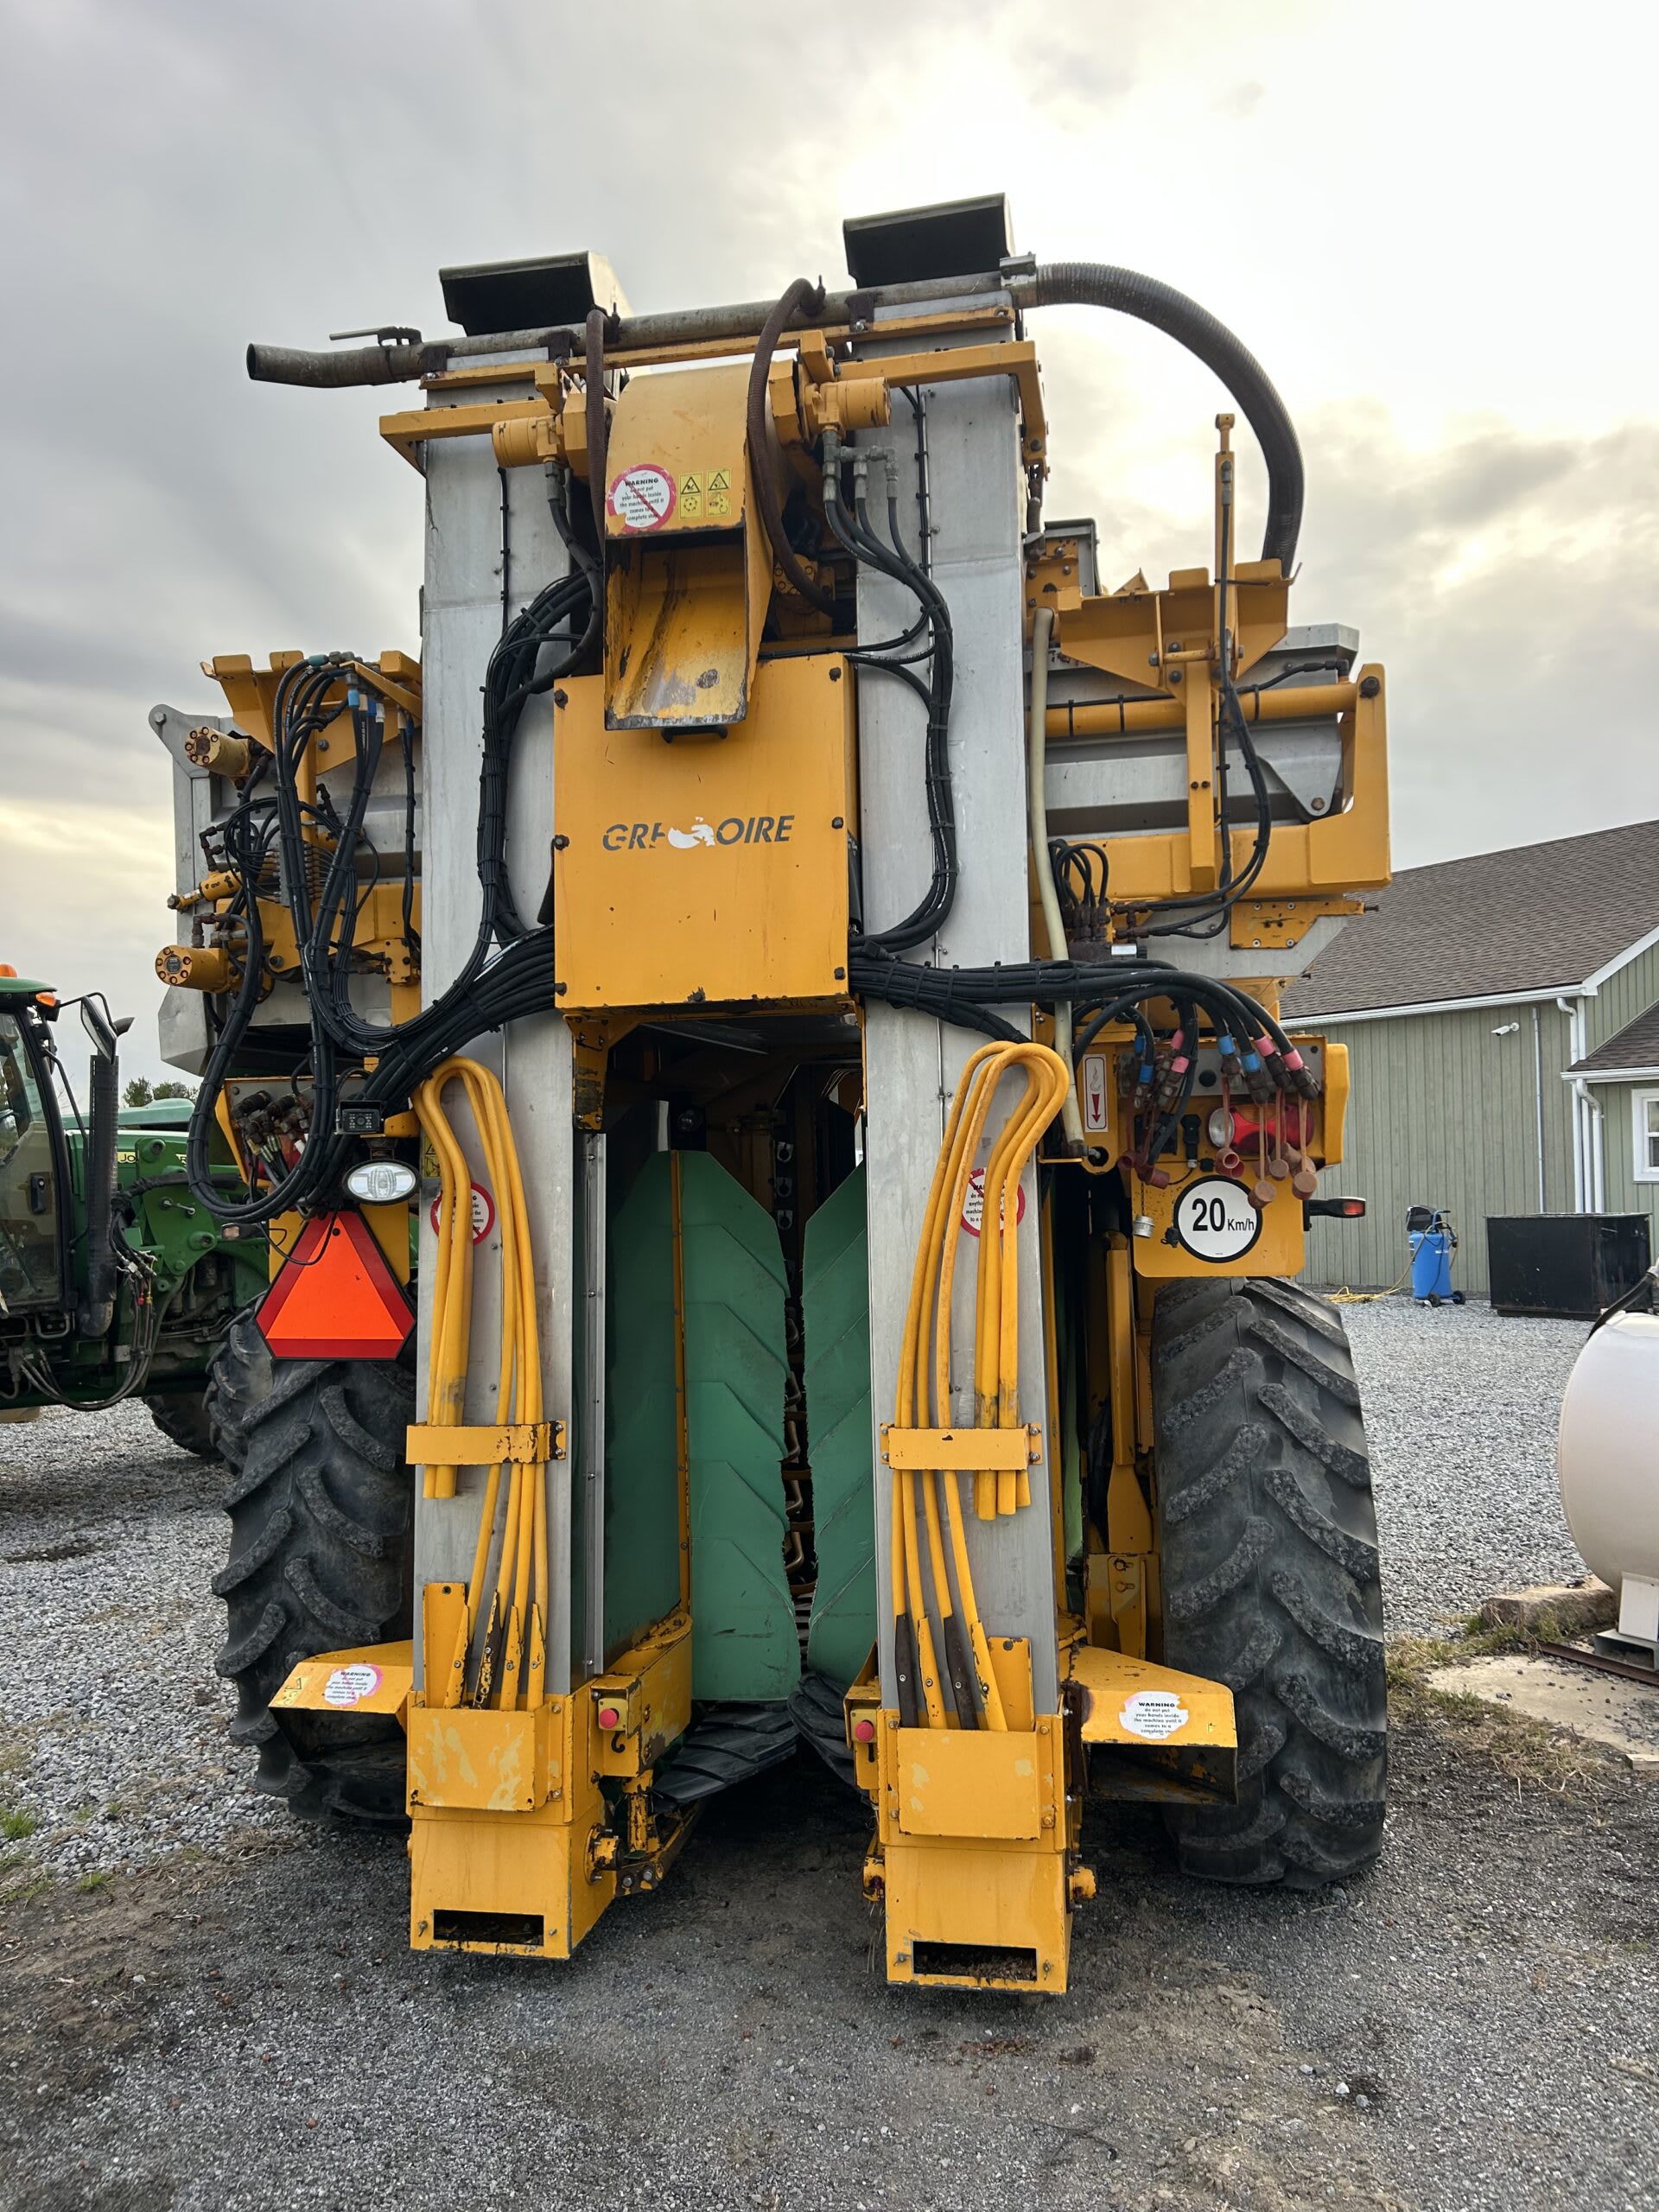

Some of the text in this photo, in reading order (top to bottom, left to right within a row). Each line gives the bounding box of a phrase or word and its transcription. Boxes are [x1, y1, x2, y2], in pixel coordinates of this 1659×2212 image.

[602, 815, 795, 851] GREOIRE
[1192, 1198, 1255, 1232] 20 Km/h
